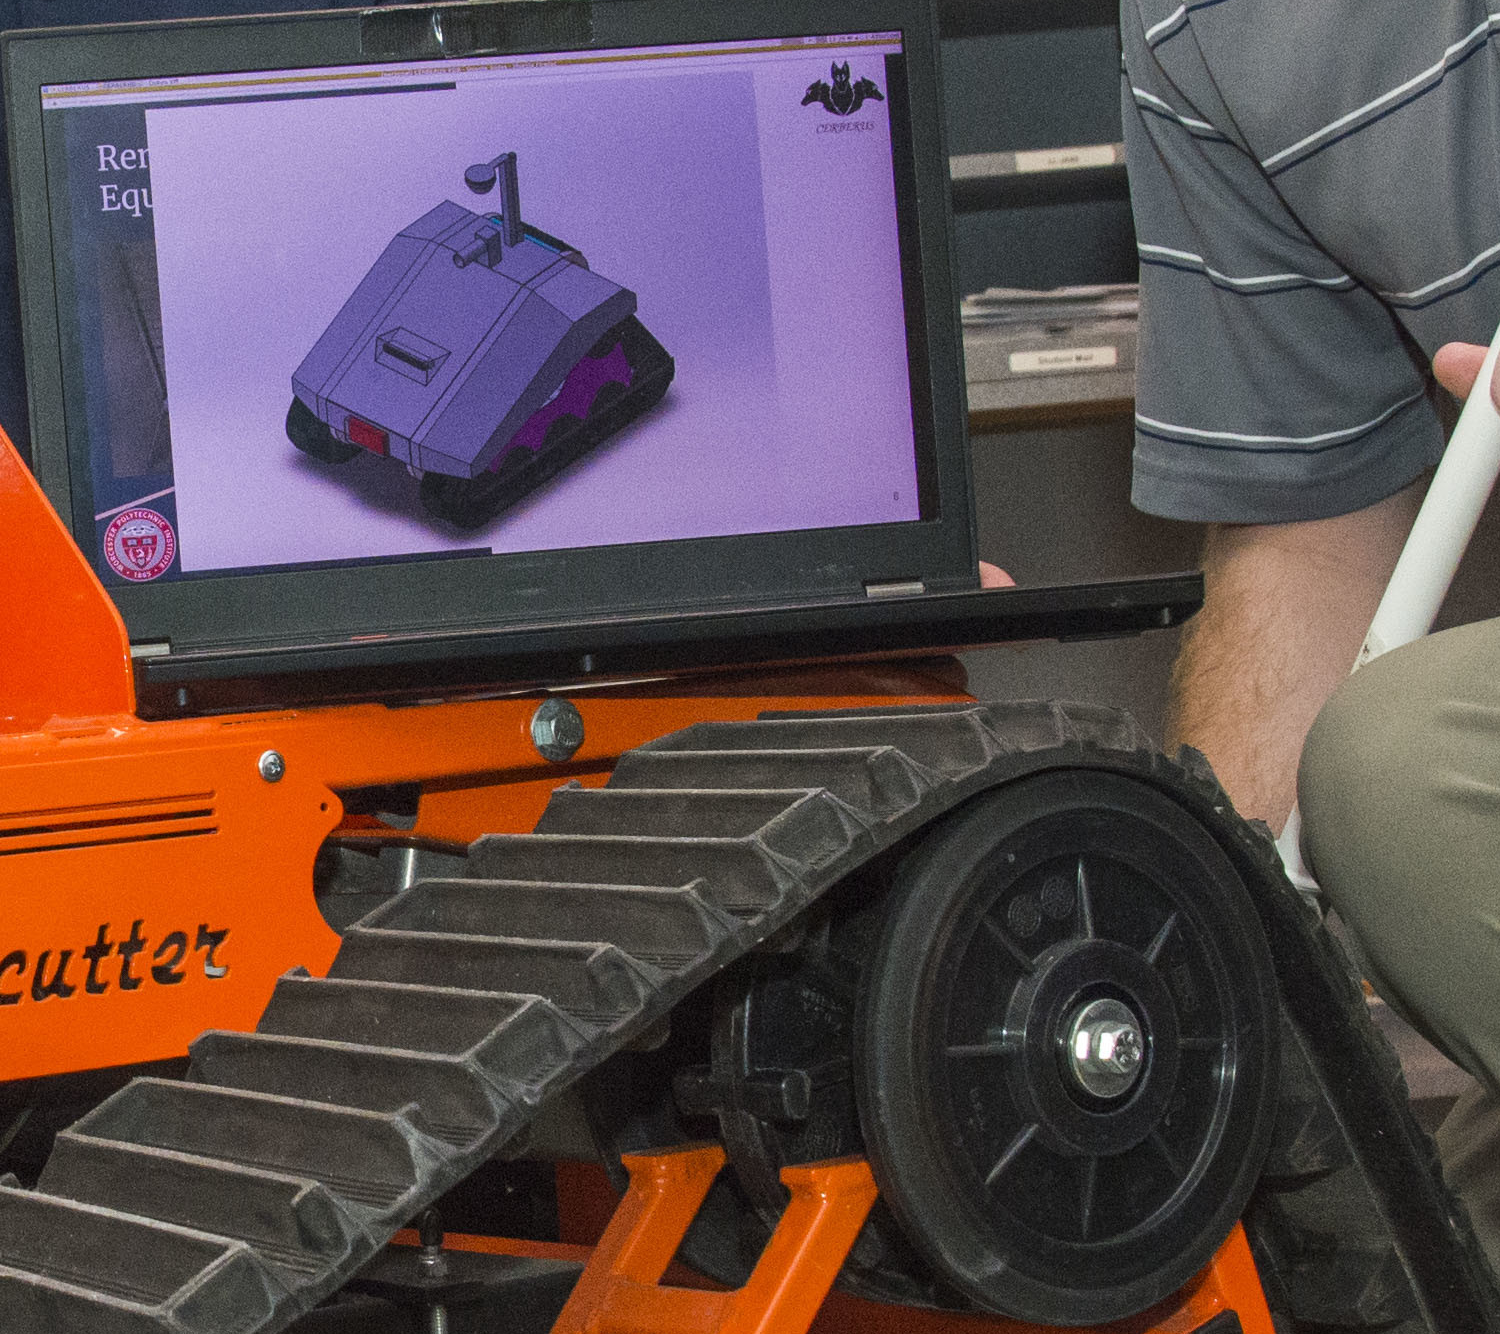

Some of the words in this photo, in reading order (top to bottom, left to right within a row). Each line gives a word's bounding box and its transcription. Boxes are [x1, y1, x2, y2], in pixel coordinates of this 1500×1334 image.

[106, 527, 124, 572] WORCESTER
[116, 511, 166, 528] POLYTECHNIC
[158, 529, 174, 569] INSTITUTE
